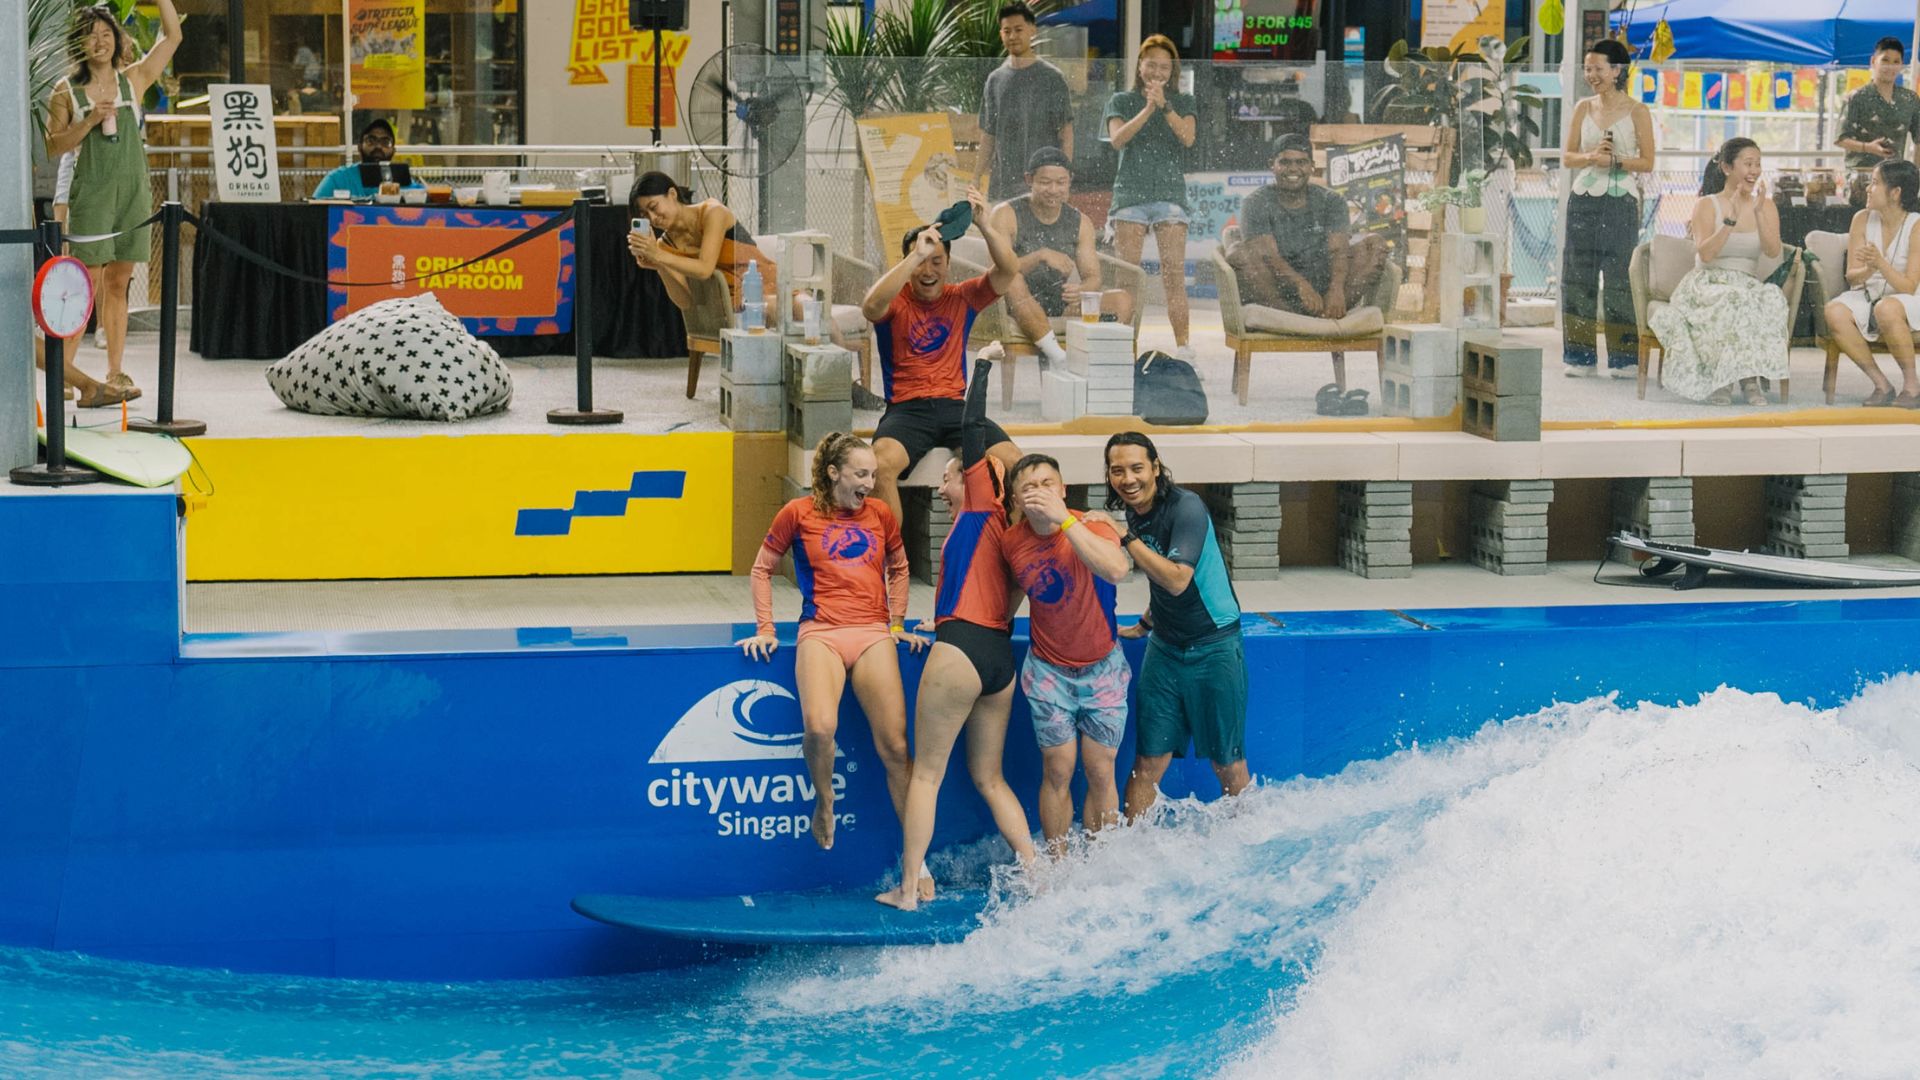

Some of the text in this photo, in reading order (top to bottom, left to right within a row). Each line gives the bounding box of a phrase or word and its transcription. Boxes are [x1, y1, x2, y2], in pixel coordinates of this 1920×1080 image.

[1245, 15, 1313, 29] 3 FOR $45
[1254, 34, 1288, 45] SOJU
[574, 38, 639, 62] LIST
[223, 90, 268, 179] 黑狗
[467, 258, 514, 274] GAO
[416, 272, 523, 290] TAPROOM
[717, 811, 857, 840] Singapre
